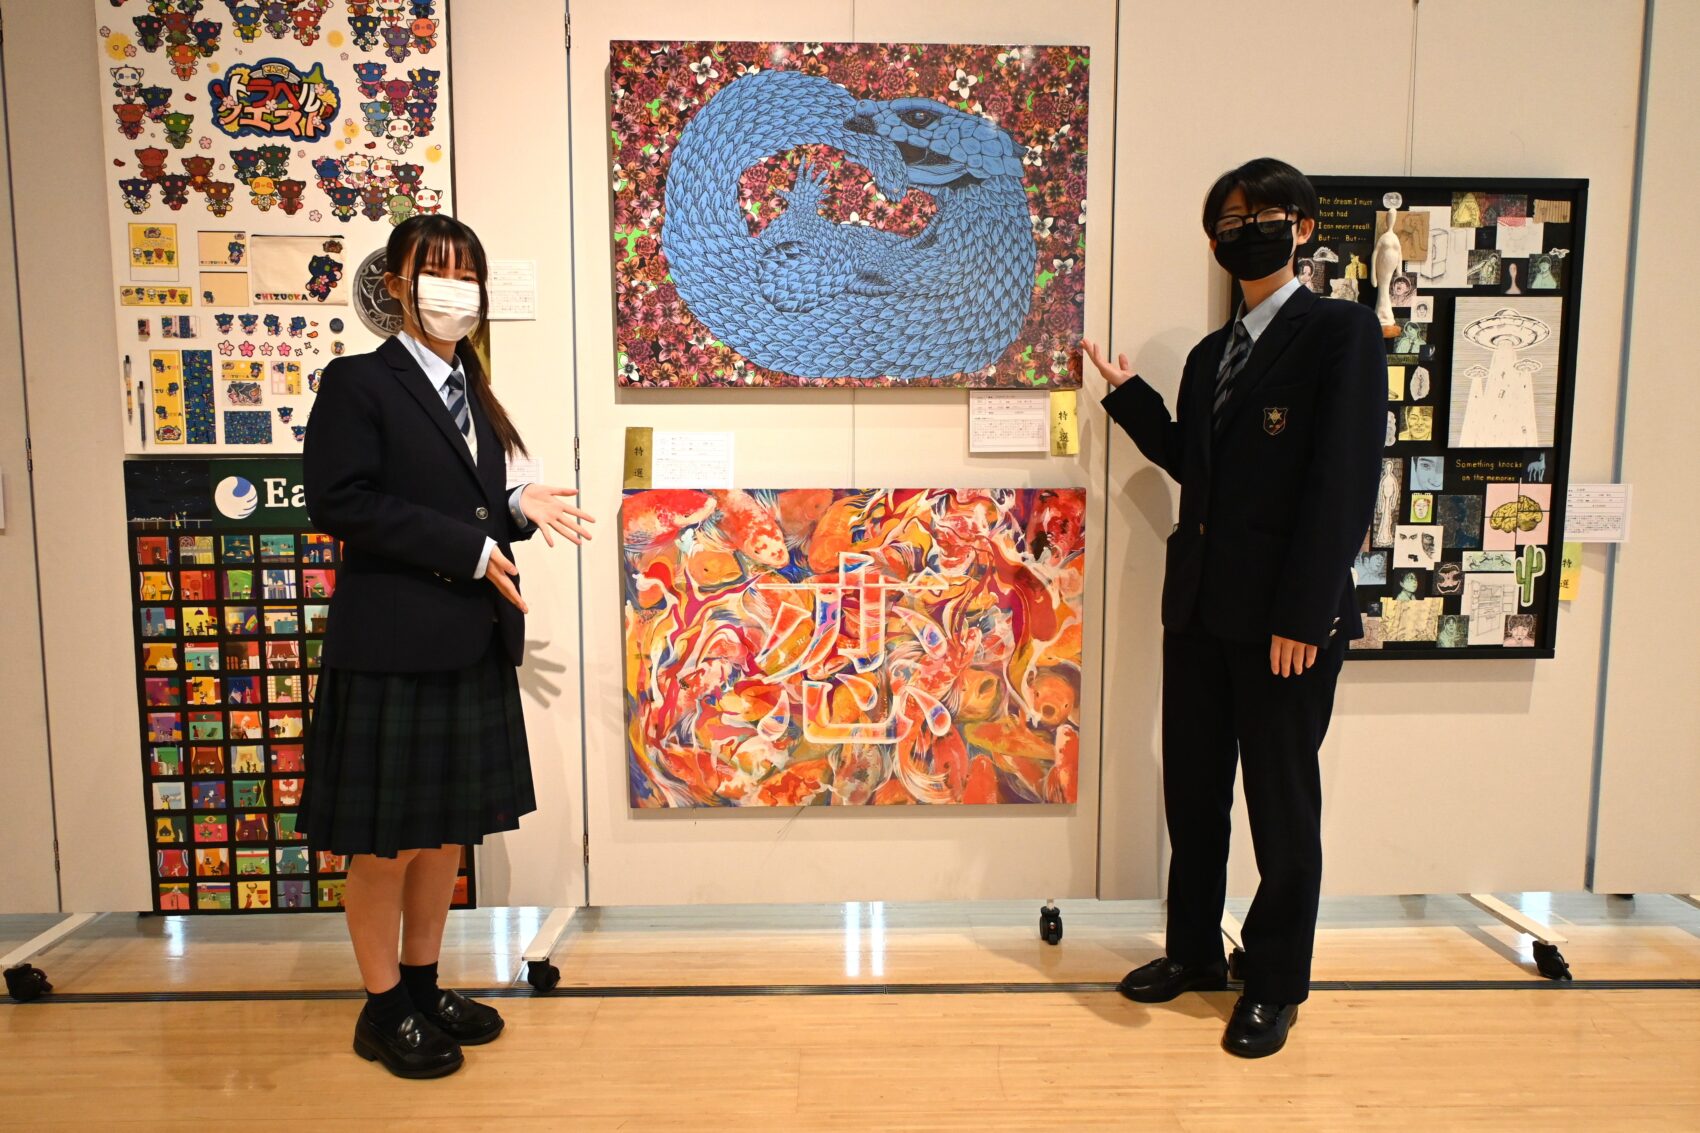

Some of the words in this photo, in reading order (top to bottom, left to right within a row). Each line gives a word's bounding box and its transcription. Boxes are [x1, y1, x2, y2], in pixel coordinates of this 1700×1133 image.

[229, 73, 321, 113] トラベル
[218, 103, 326, 137] クエスト
[1319, 196, 1331, 205] The
[1319, 209, 1334, 217] have
[255, 293, 308, 301] SHIZUOKA
[633, 446, 644, 478] 特選
[1455, 459, 1494, 470] Something
